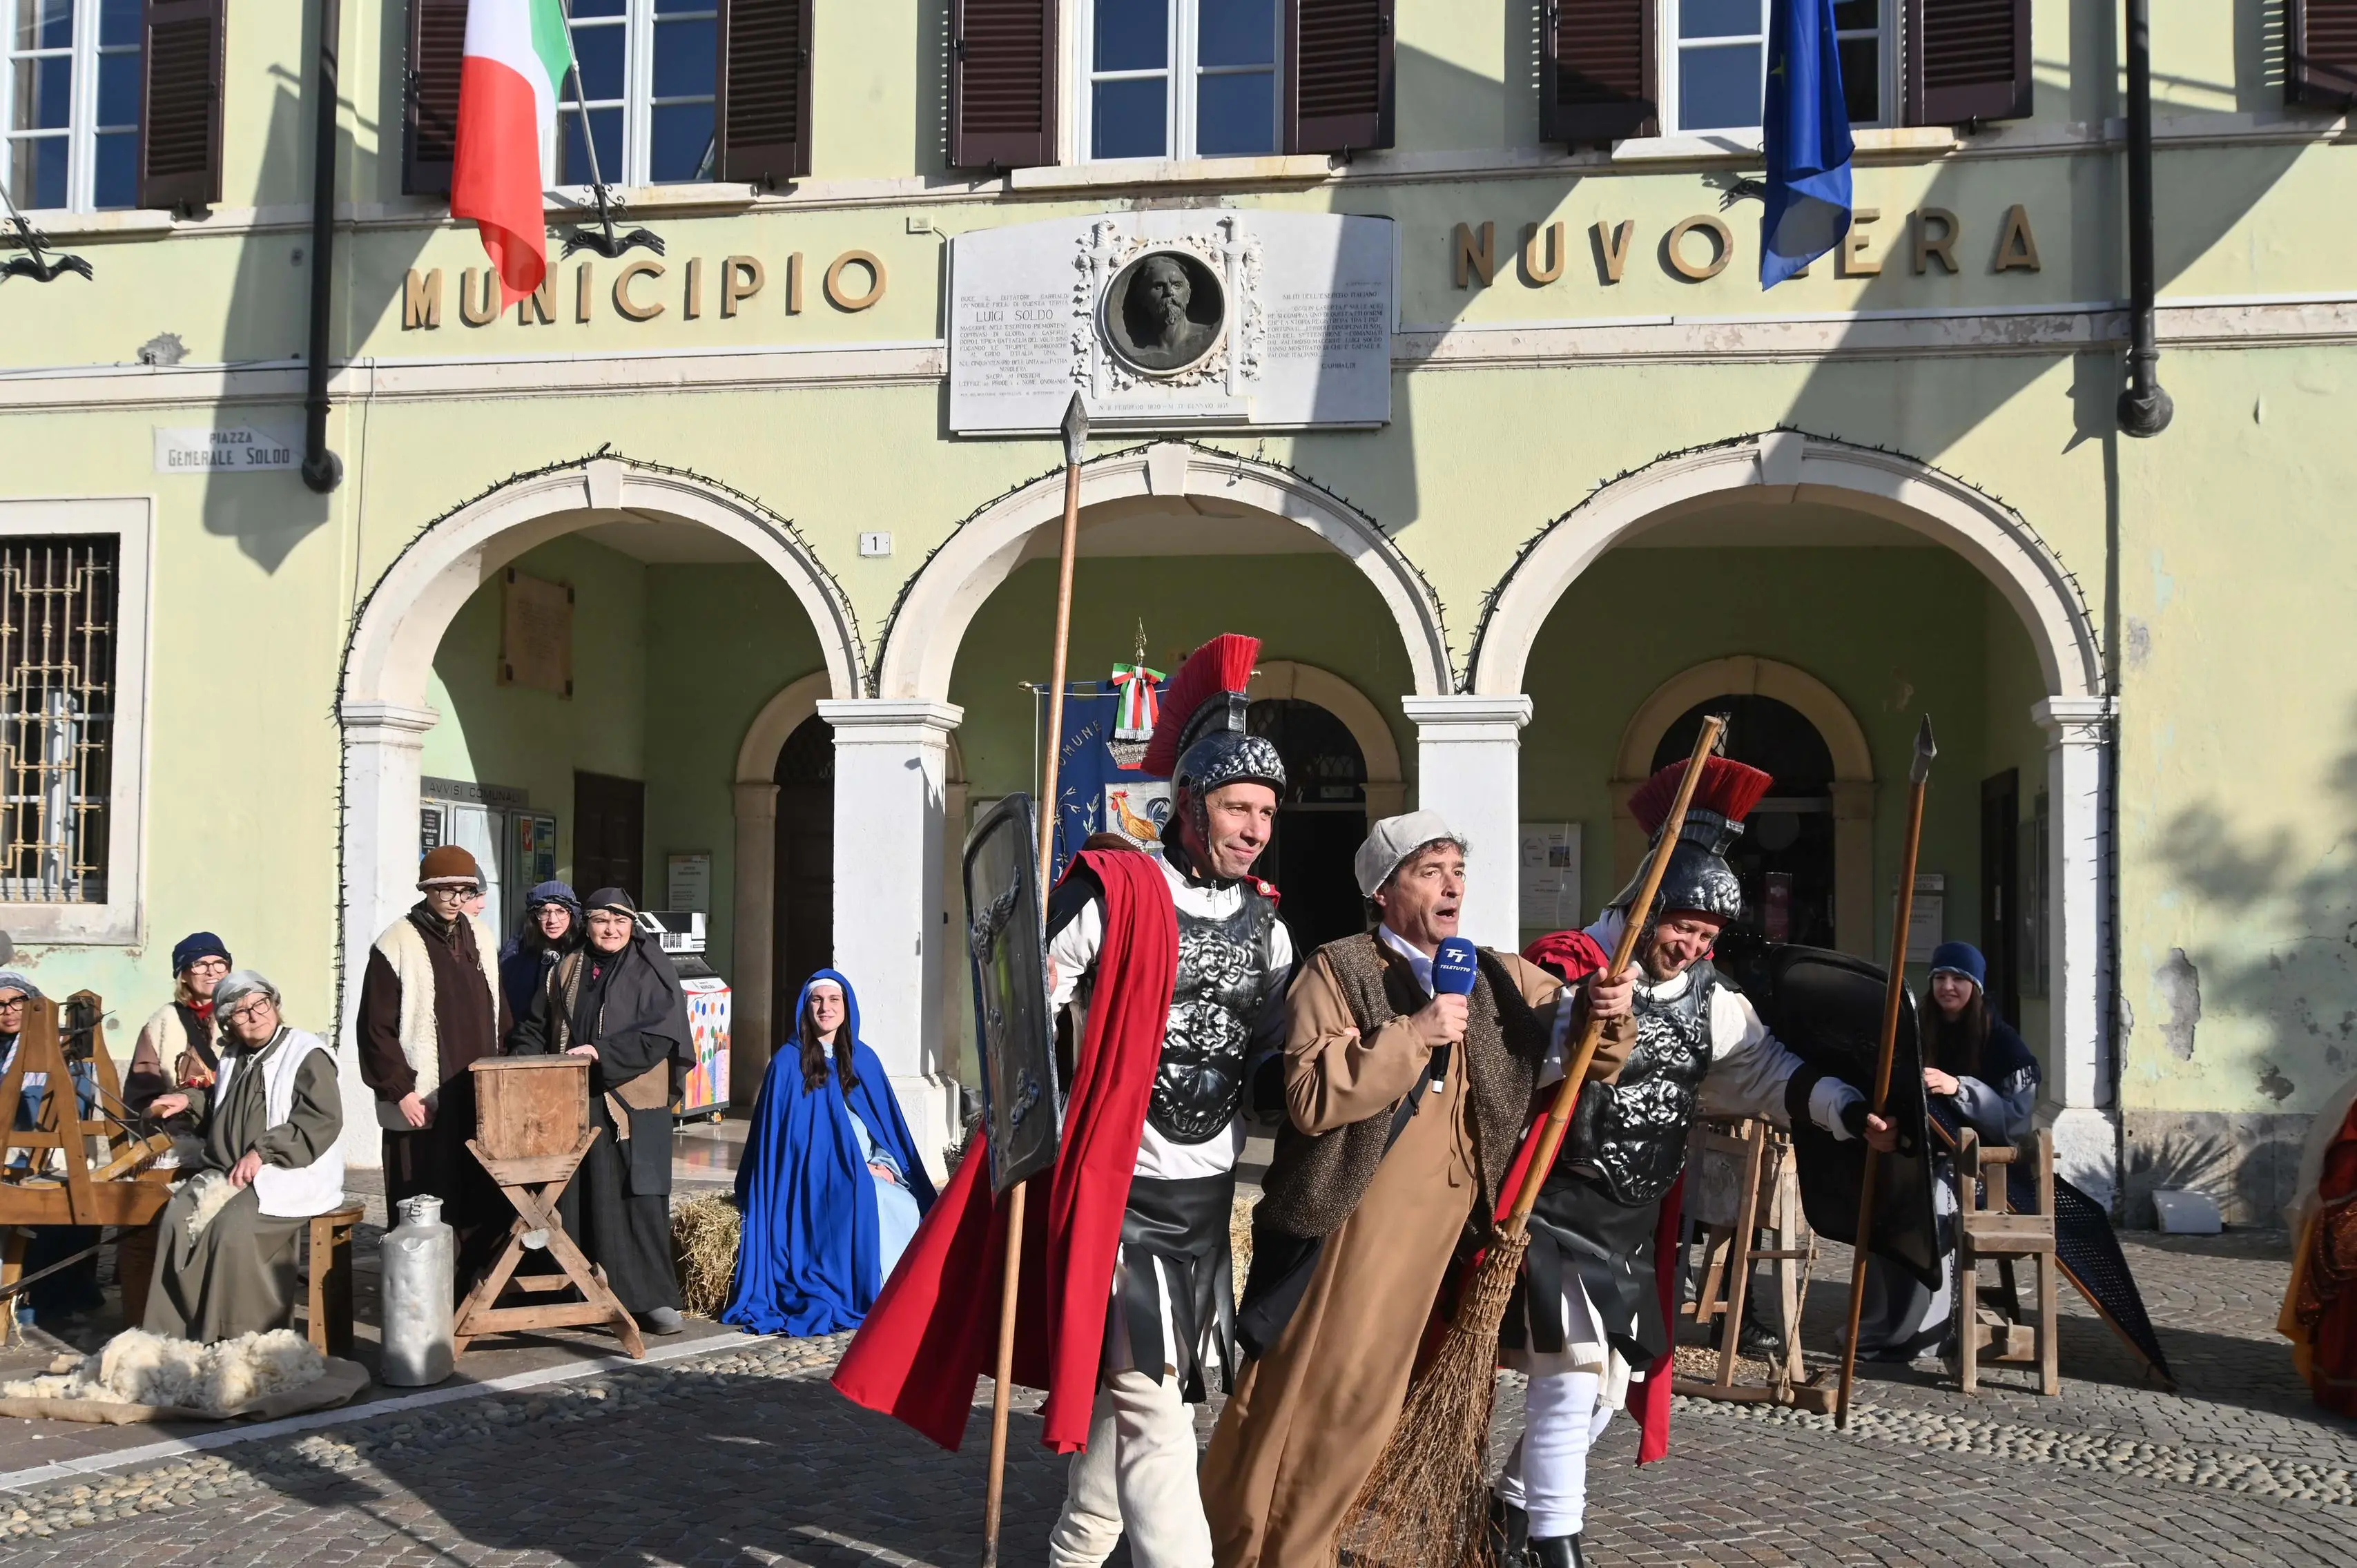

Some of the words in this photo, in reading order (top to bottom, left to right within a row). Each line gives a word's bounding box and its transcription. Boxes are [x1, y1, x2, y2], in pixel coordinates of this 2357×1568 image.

[1457, 204, 2041, 288] NUVOERA
[403, 250, 887, 329] MUNICIPIO
[976, 311, 1003, 322] LUIGI
[1014, 309, 1054, 321] SOLDO
[209, 432, 253, 444] PIAZZA
[168, 449, 235, 466] GENERALE
[246, 447, 290, 465] SOLDO
[872, 536, 877, 551] 1
[1057, 719, 1103, 768] OMUNE
[429, 782, 463, 796] AVVISI
[469, 788, 521, 803] COMUNALI
[1439, 964, 1471, 973] TELETUTTO
